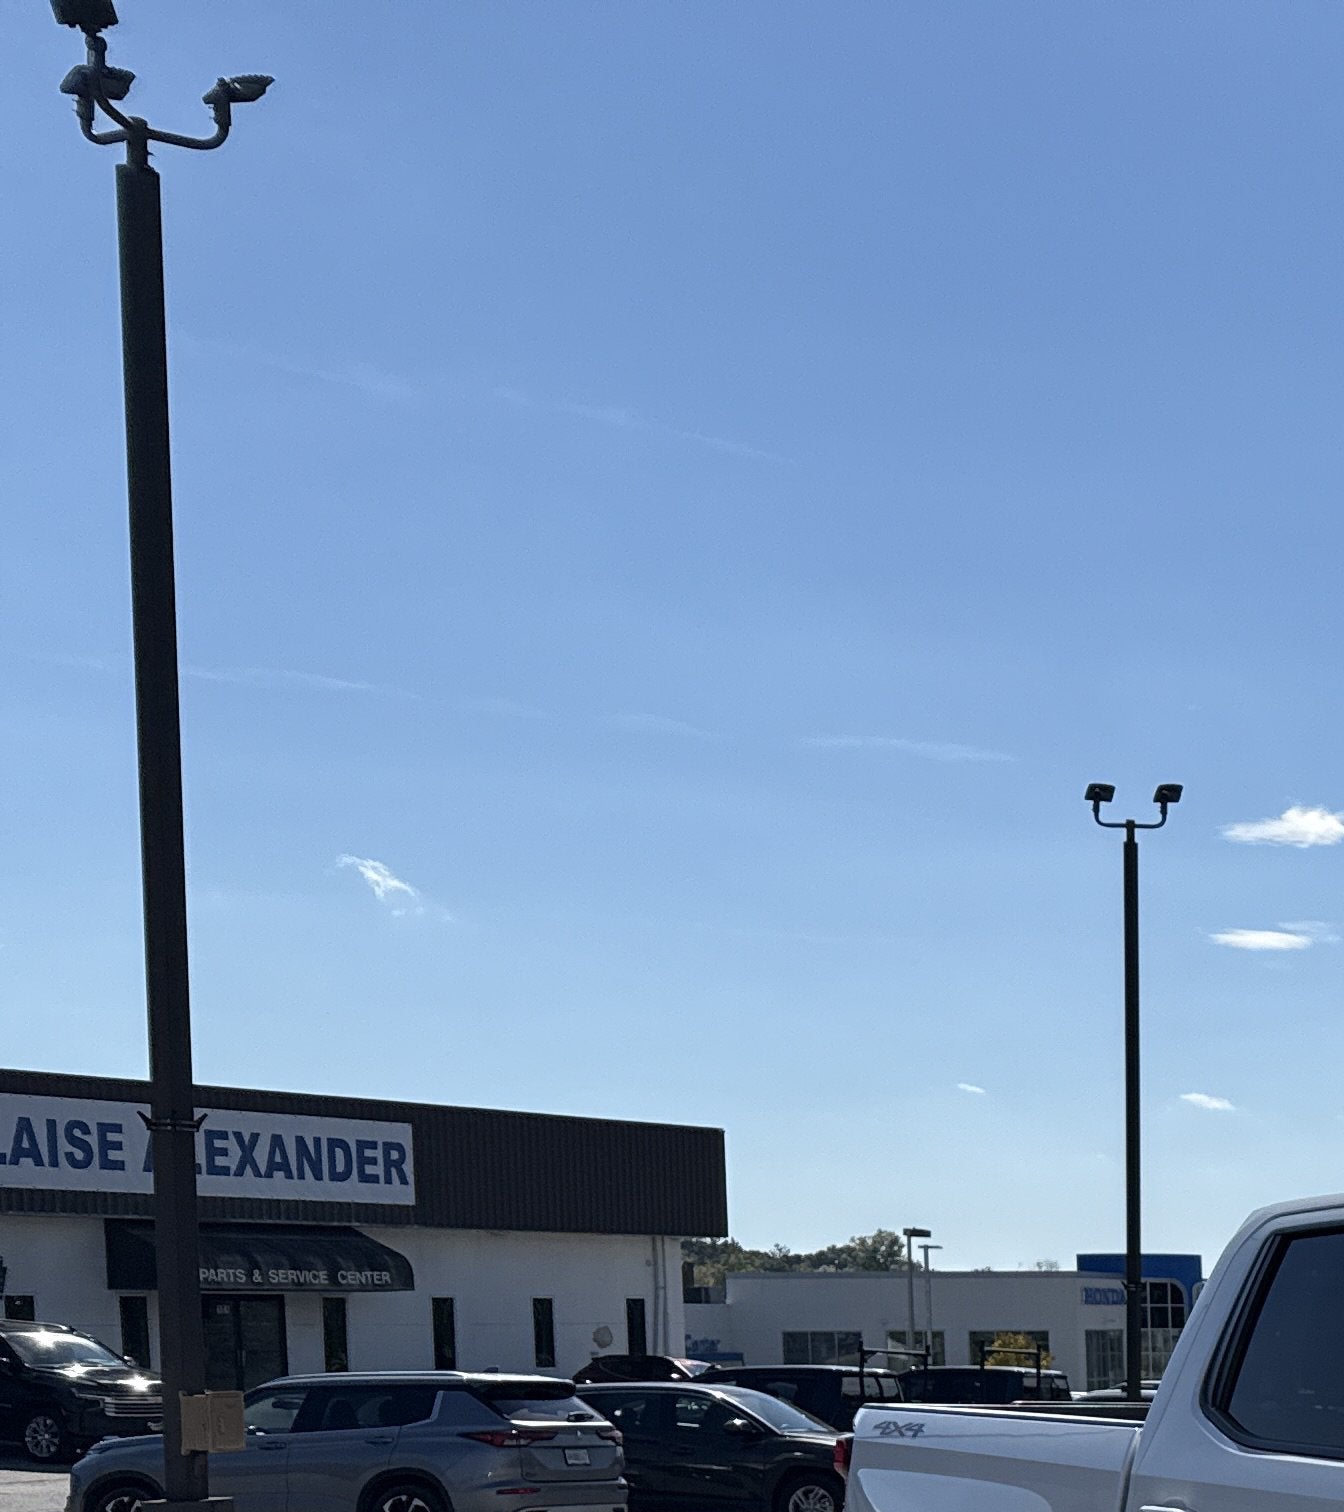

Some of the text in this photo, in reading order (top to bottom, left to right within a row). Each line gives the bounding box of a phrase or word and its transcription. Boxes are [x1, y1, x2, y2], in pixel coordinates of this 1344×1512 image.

[142, 1128, 410, 1186] EXANDER
[199, 1268, 391, 1284] PARTS & SERVICE CENTER
